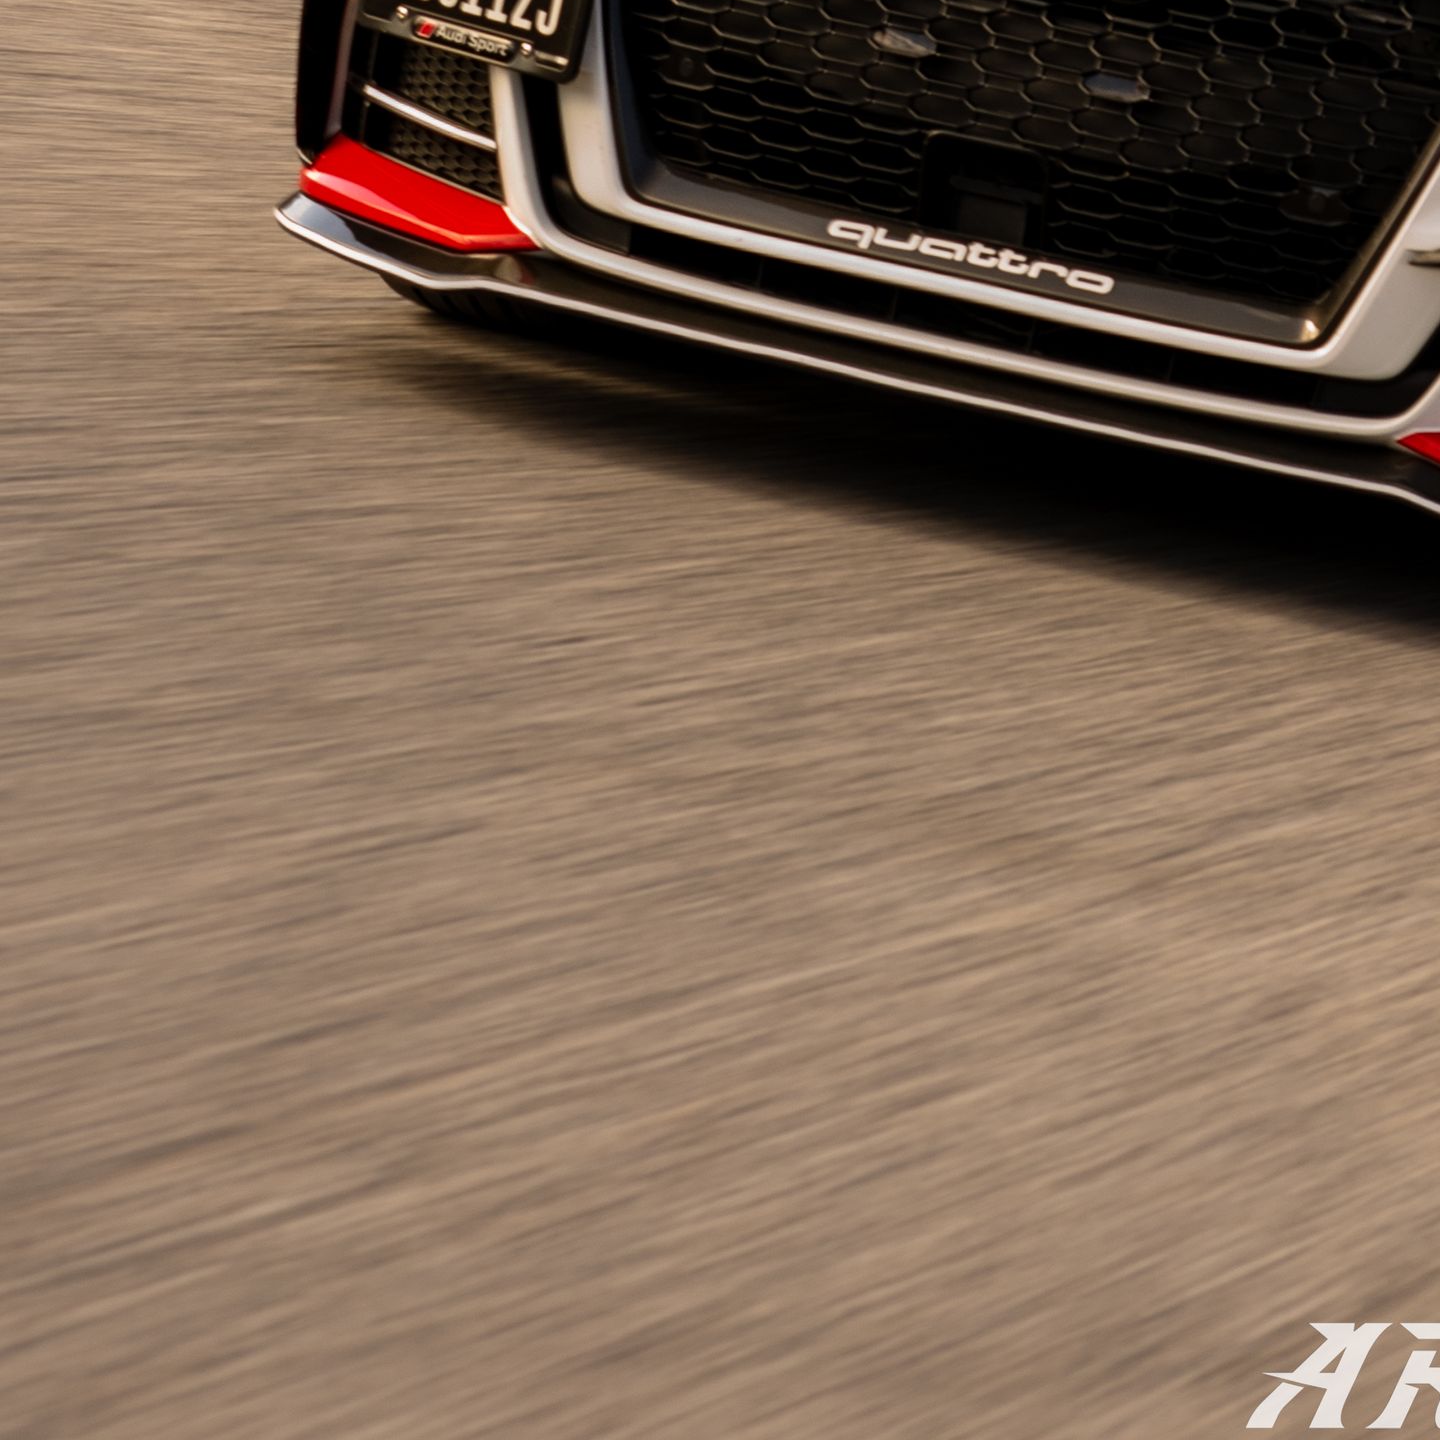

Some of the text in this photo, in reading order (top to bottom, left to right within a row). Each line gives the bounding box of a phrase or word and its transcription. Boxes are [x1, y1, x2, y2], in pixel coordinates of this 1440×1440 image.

[434, 23, 510, 57] Audi Sport
[826, 218, 1116, 295] quattro
